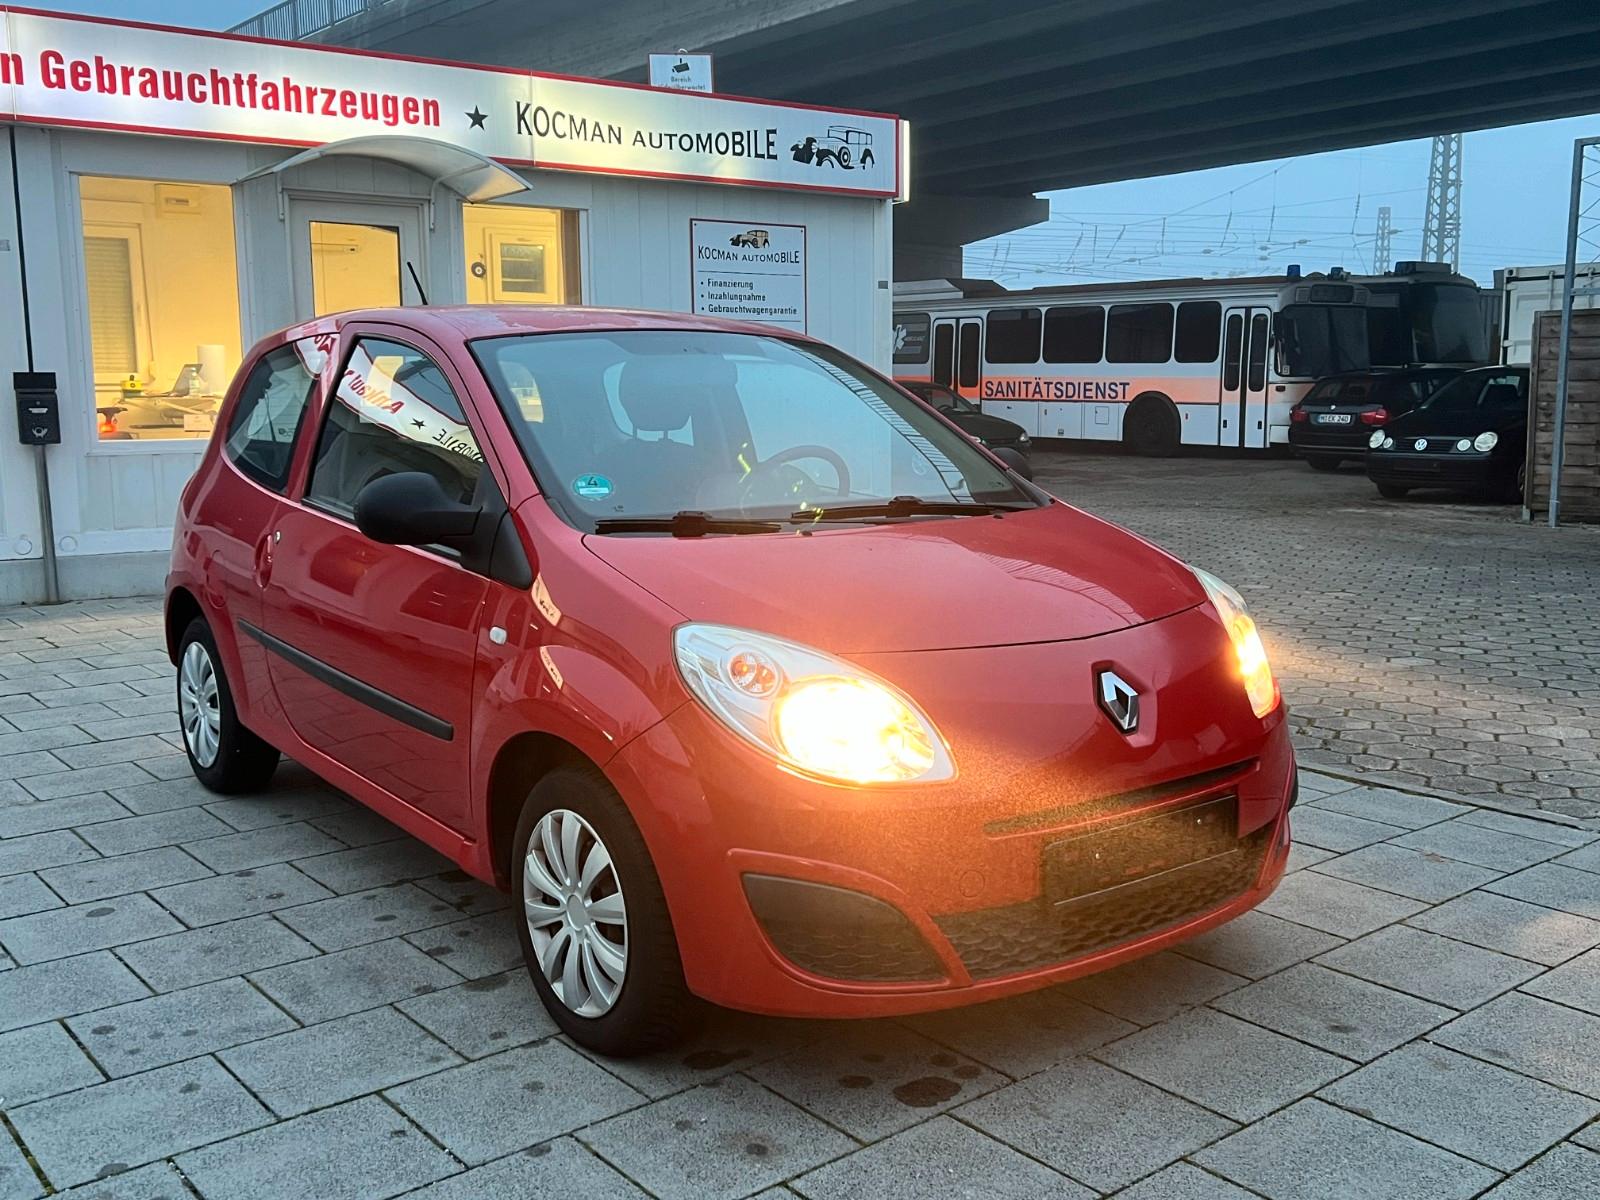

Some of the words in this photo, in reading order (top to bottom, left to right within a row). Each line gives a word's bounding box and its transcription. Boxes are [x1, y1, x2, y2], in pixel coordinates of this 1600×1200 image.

[40, 49, 441, 127] Gebrauchtfahrzeugen
[516, 101, 622, 145] KOCMAN
[632, 128, 778, 161] AUTOMOBILE
[698, 245, 738, 261] KOCMAN
[743, 251, 799, 264] AUTOMOBILE
[707, 278, 754, 290] Finanzierung
[707, 292, 766, 302] Inzahlungnahme
[708, 304, 798, 316] Gebrauchtwagengarantie
[984, 377, 1130, 400] SANITÄTSDIENST
[587, 476, 598, 486] 4
